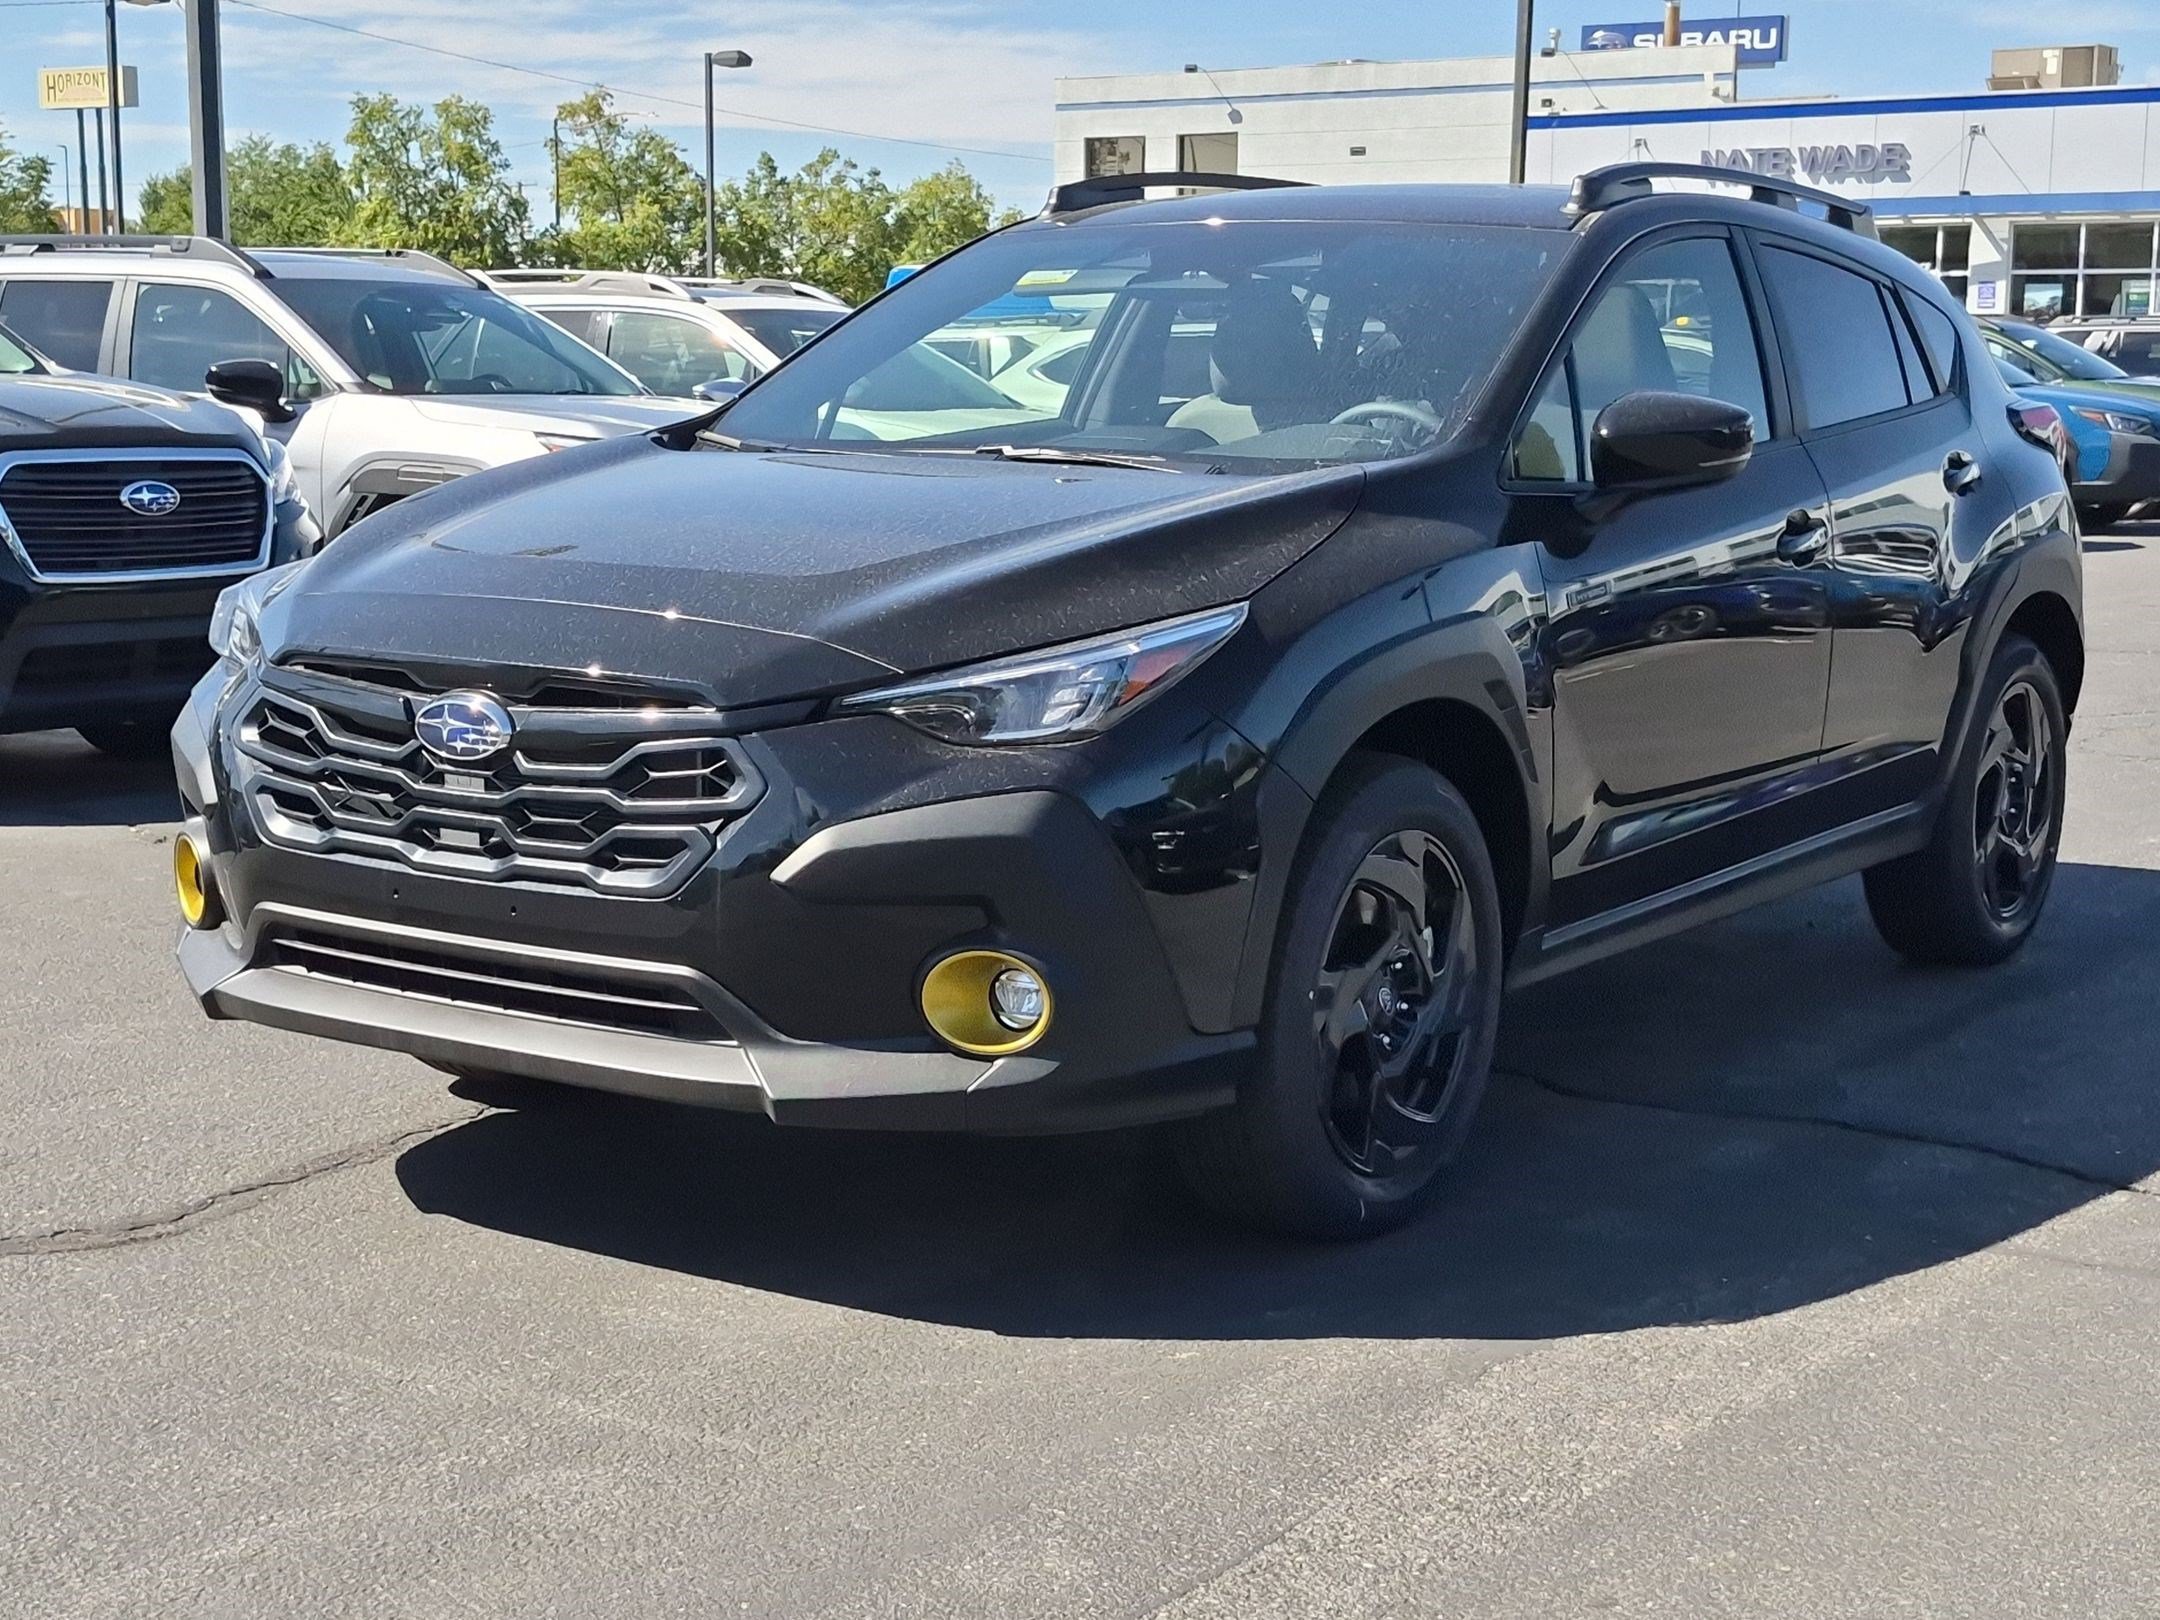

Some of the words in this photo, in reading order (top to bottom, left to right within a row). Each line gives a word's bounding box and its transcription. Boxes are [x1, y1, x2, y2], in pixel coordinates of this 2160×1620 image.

[1633, 28, 1777, 49] SBARU
[46, 71, 106, 103] HORIZONT
[1700, 147, 1793, 174] NATE
[1798, 143, 1906, 174] WADE
